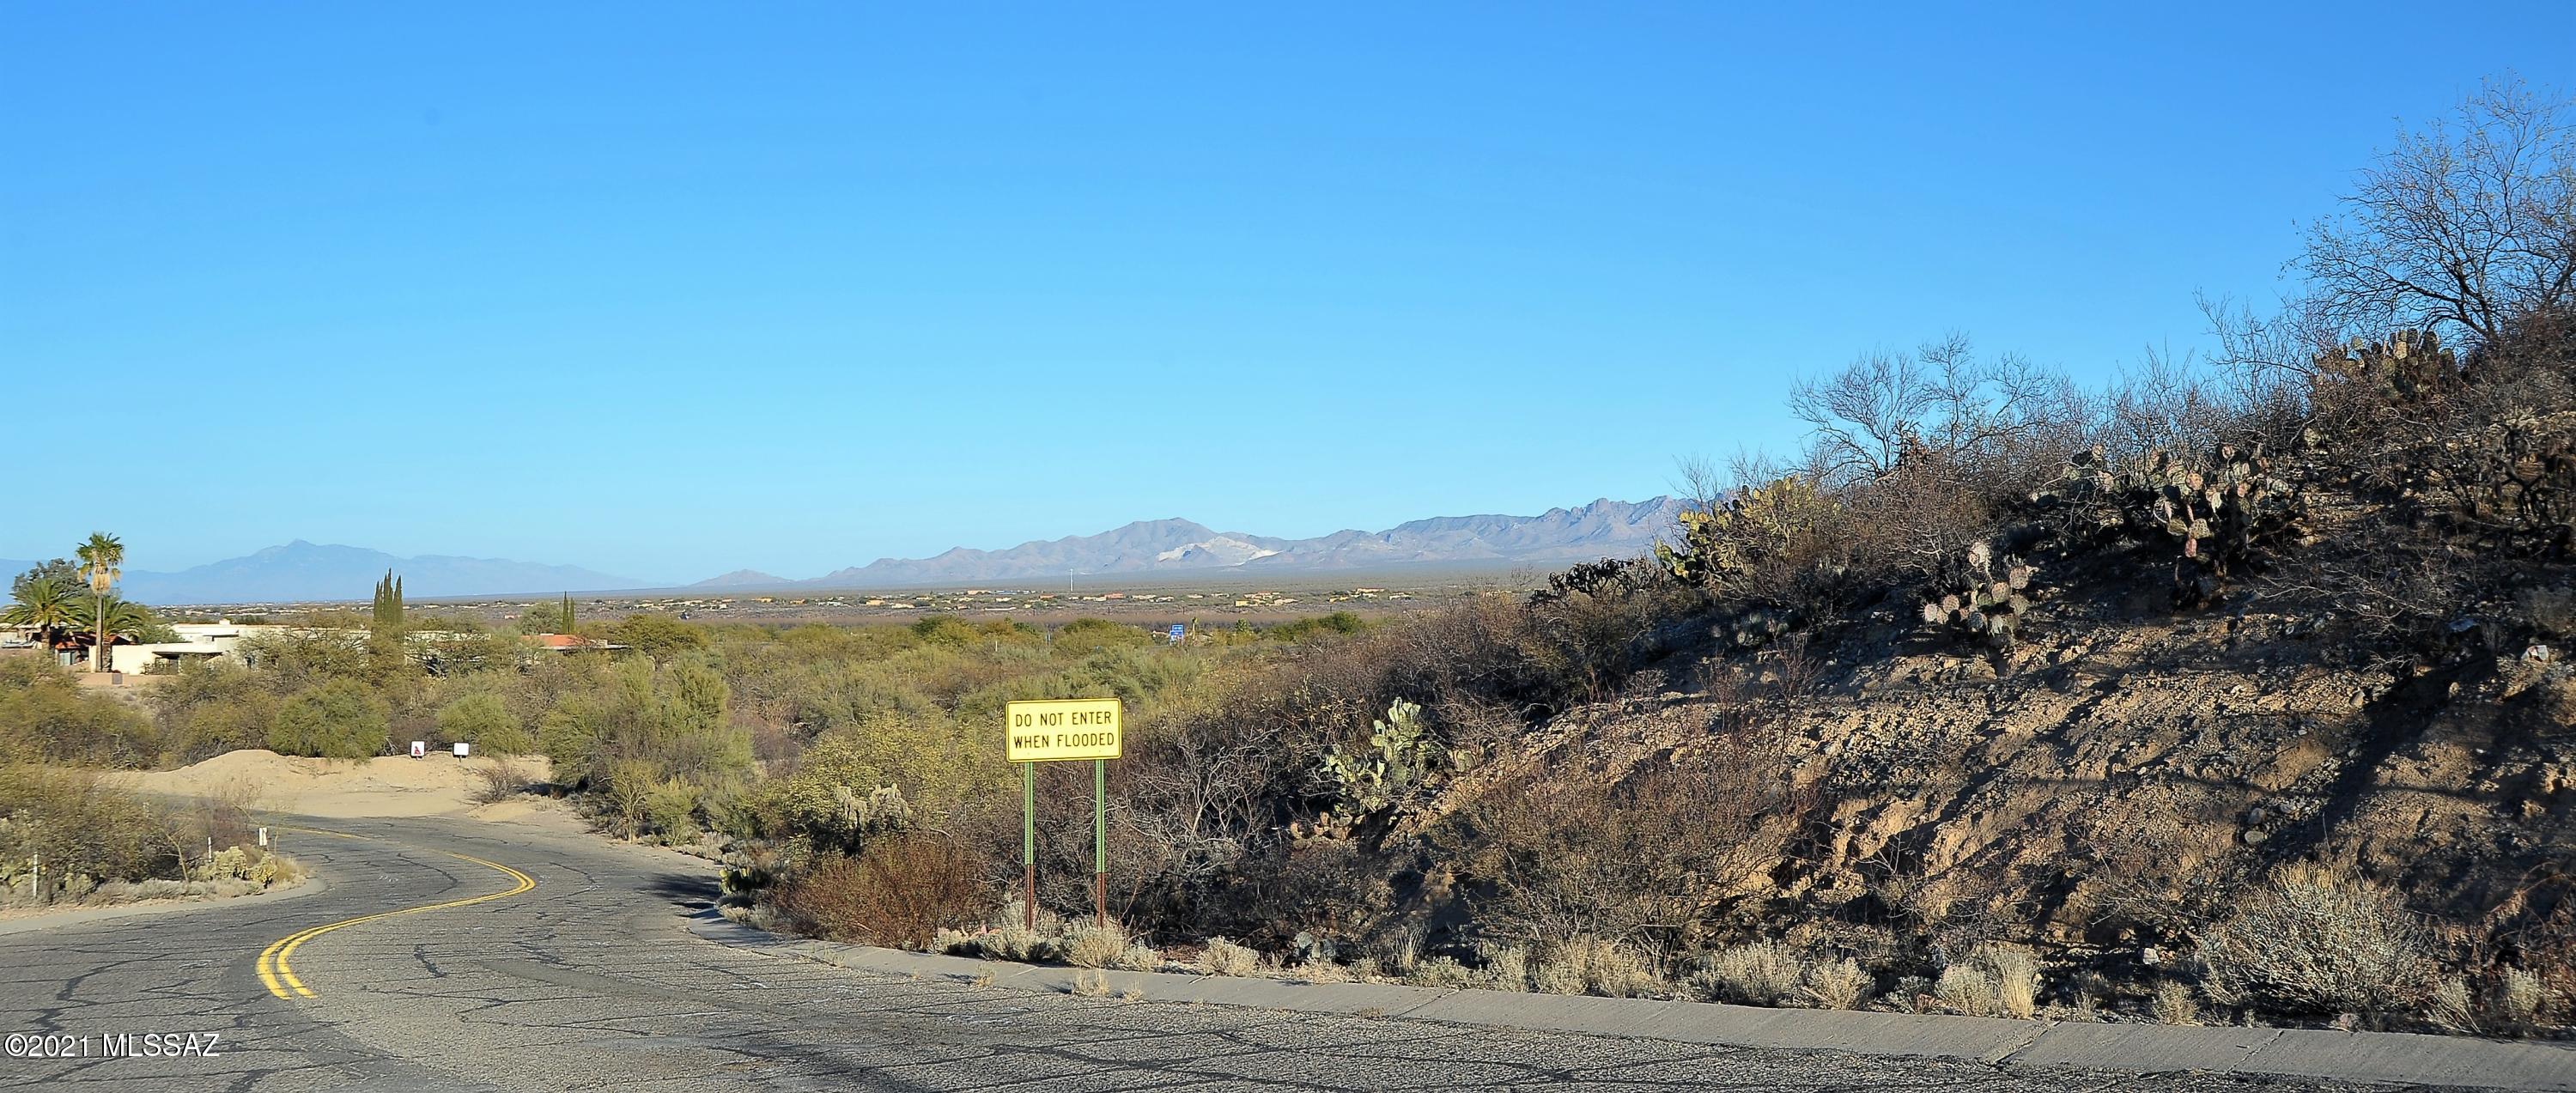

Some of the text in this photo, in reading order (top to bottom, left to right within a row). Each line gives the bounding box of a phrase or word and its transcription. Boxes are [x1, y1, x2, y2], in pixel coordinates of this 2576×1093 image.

[1015, 711, 1112, 727] DO NOT ENTER
[1013, 732, 1115, 749] WHEN FLOODED
